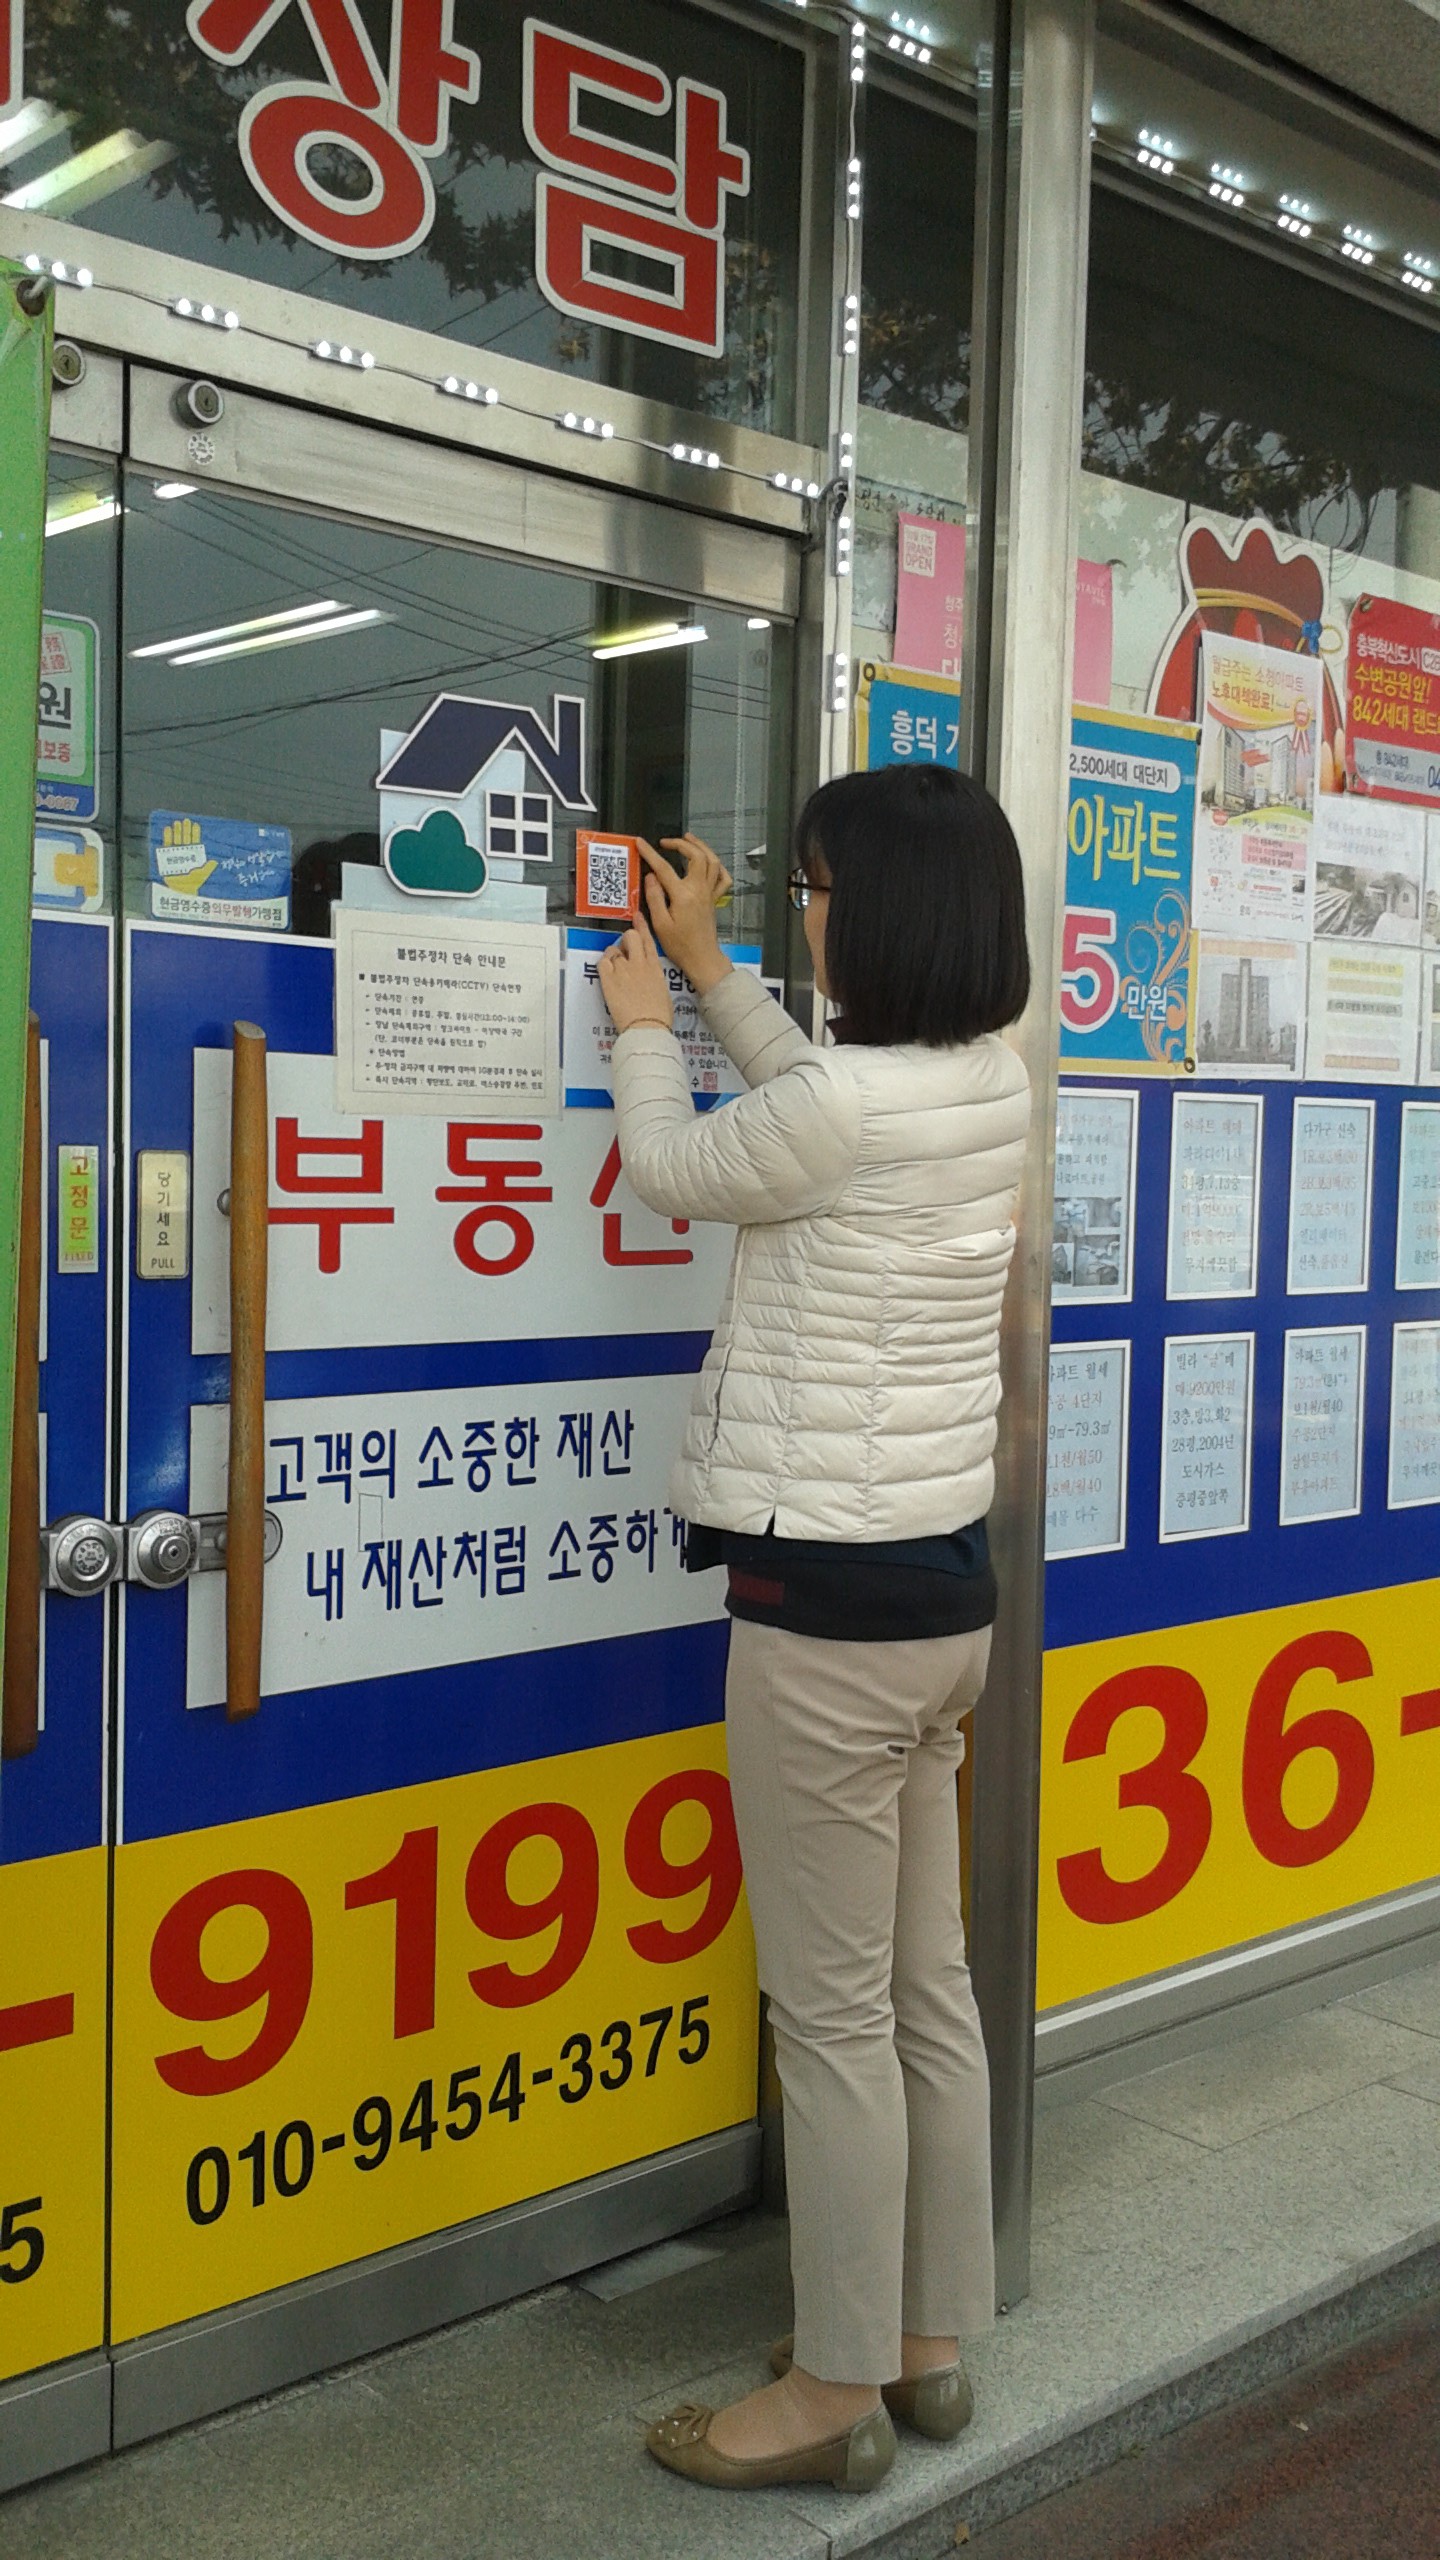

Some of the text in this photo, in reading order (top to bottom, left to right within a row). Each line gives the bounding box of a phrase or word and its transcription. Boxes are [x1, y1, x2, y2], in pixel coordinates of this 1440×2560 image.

[187, 0, 750, 358] 상담
[906, 553, 933, 571] OPEN
[1355, 662, 1432, 704] 수변공원앞!
[890, 710, 938, 760] 흥덕
[1353, 695, 1410, 731] 842세대
[1133, 764, 1169, 788] 대단지
[1068, 794, 1182, 886] 아파트
[397, 948, 506, 969] 불법주정차 단속 안내문
[1127, 983, 1168, 1022] 만원
[69, 1155, 90, 1241] 고정문
[157, 1172, 172, 1247] 당기세요
[151, 1256, 176, 1270] PULL
[267, 1409, 635, 1503] 고객의 소중한 재산
[1182, 1462, 1225, 1480] 도시가스
[306, 1547, 343, 1621] 내
[361, 1525, 526, 1611] 재산처럼
[186, 1995, 711, 2226] 010-9454-3375
